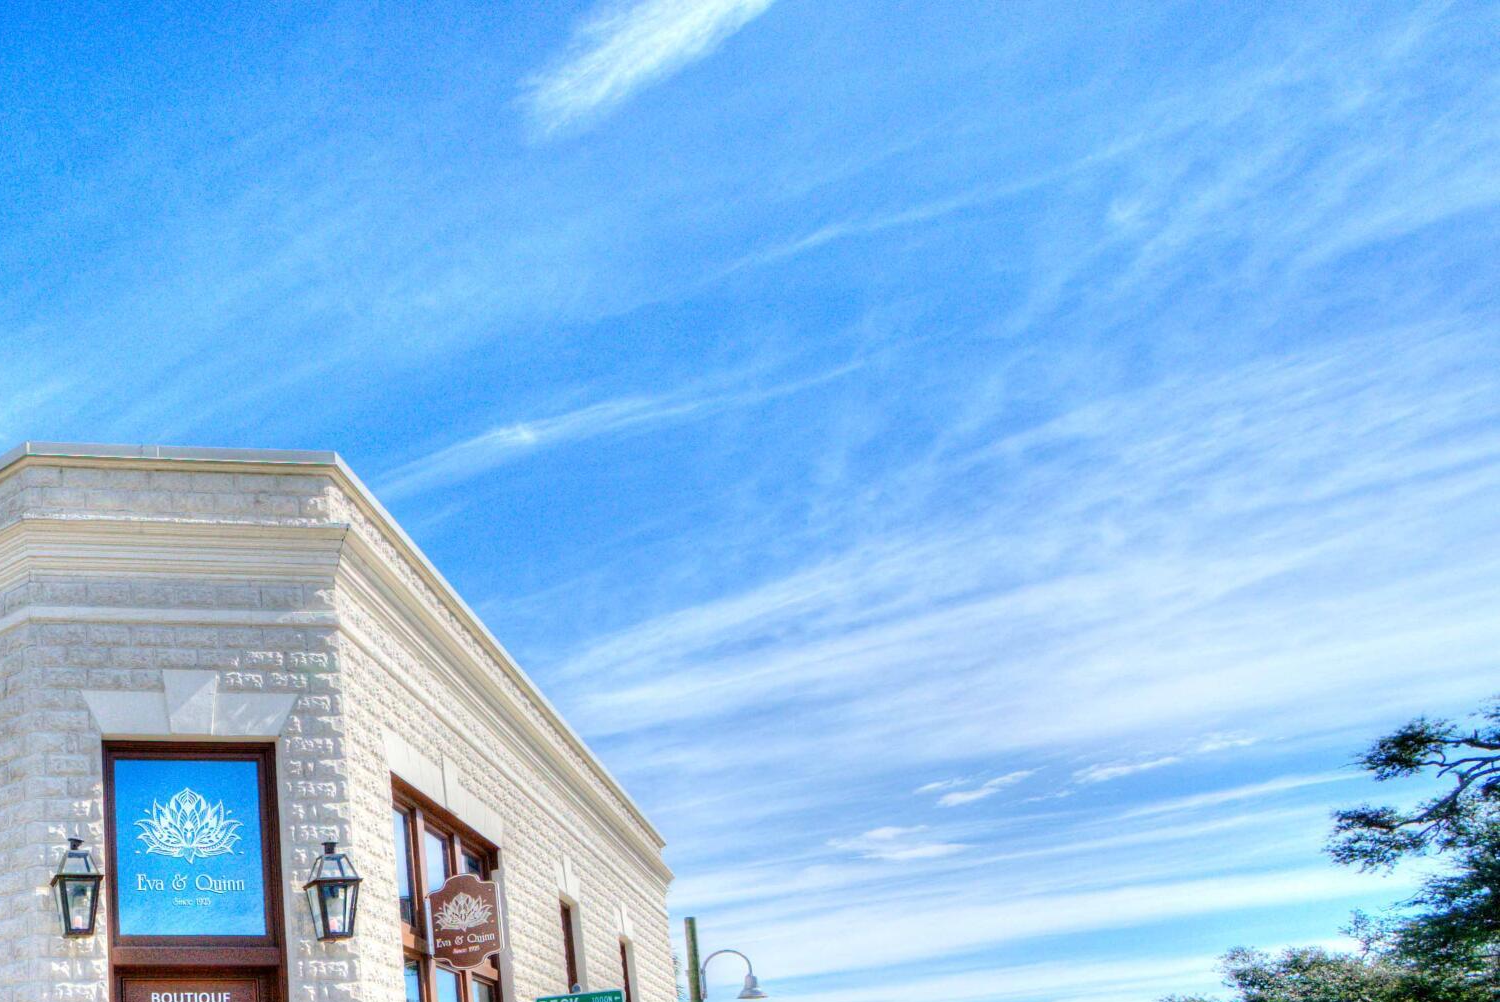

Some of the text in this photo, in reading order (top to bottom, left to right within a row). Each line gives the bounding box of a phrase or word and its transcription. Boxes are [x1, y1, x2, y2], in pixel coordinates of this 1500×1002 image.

[136, 873, 245, 893] Eva & Quinn
[436, 932, 495, 948] Eva & Quinn
